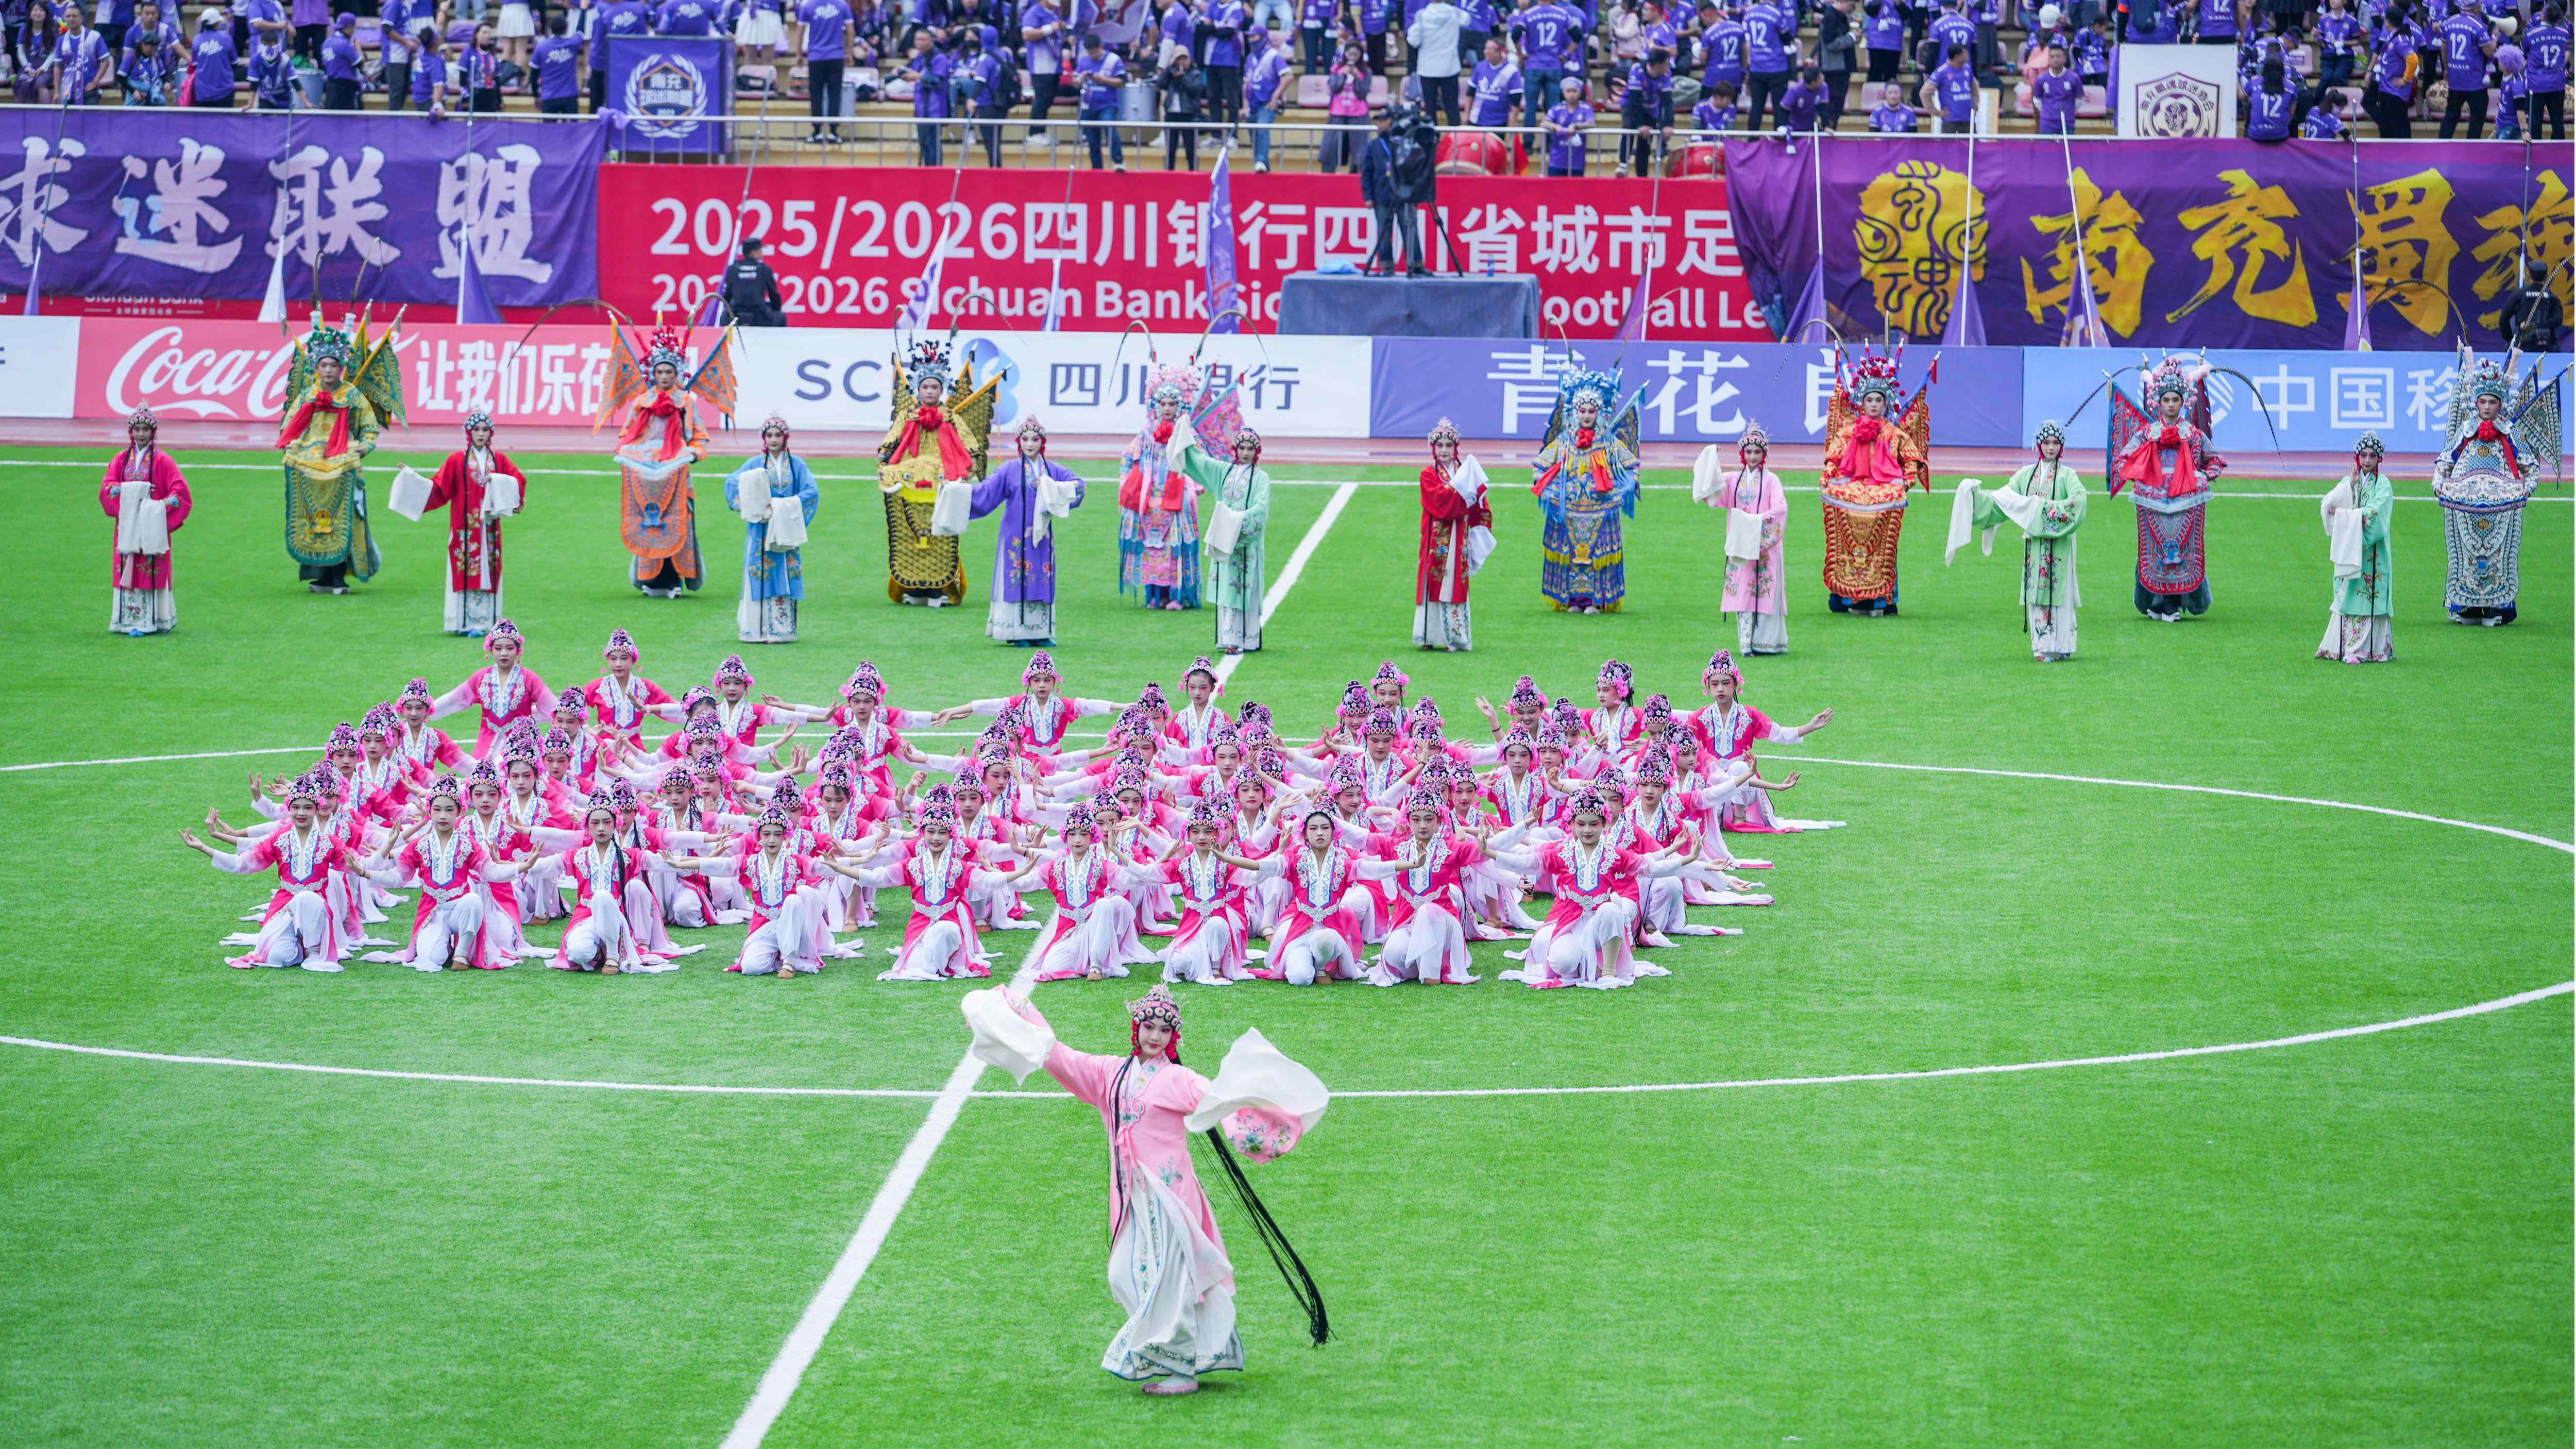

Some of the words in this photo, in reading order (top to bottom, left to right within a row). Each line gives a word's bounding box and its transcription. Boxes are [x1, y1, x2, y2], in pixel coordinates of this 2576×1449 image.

[1536, 22, 1557, 47] 12
[1749, 20, 1768, 46] 12
[1721, 35, 1739, 61] 12
[2449, 32, 2467, 61] 12
[2540, 44, 2561, 68] 12
[2260, 92, 2283, 118] 12
[1095, 279, 1210, 320] Bank
[1540, 287, 1707, 329] ootall
[2252, 363, 2553, 432] 中国移
